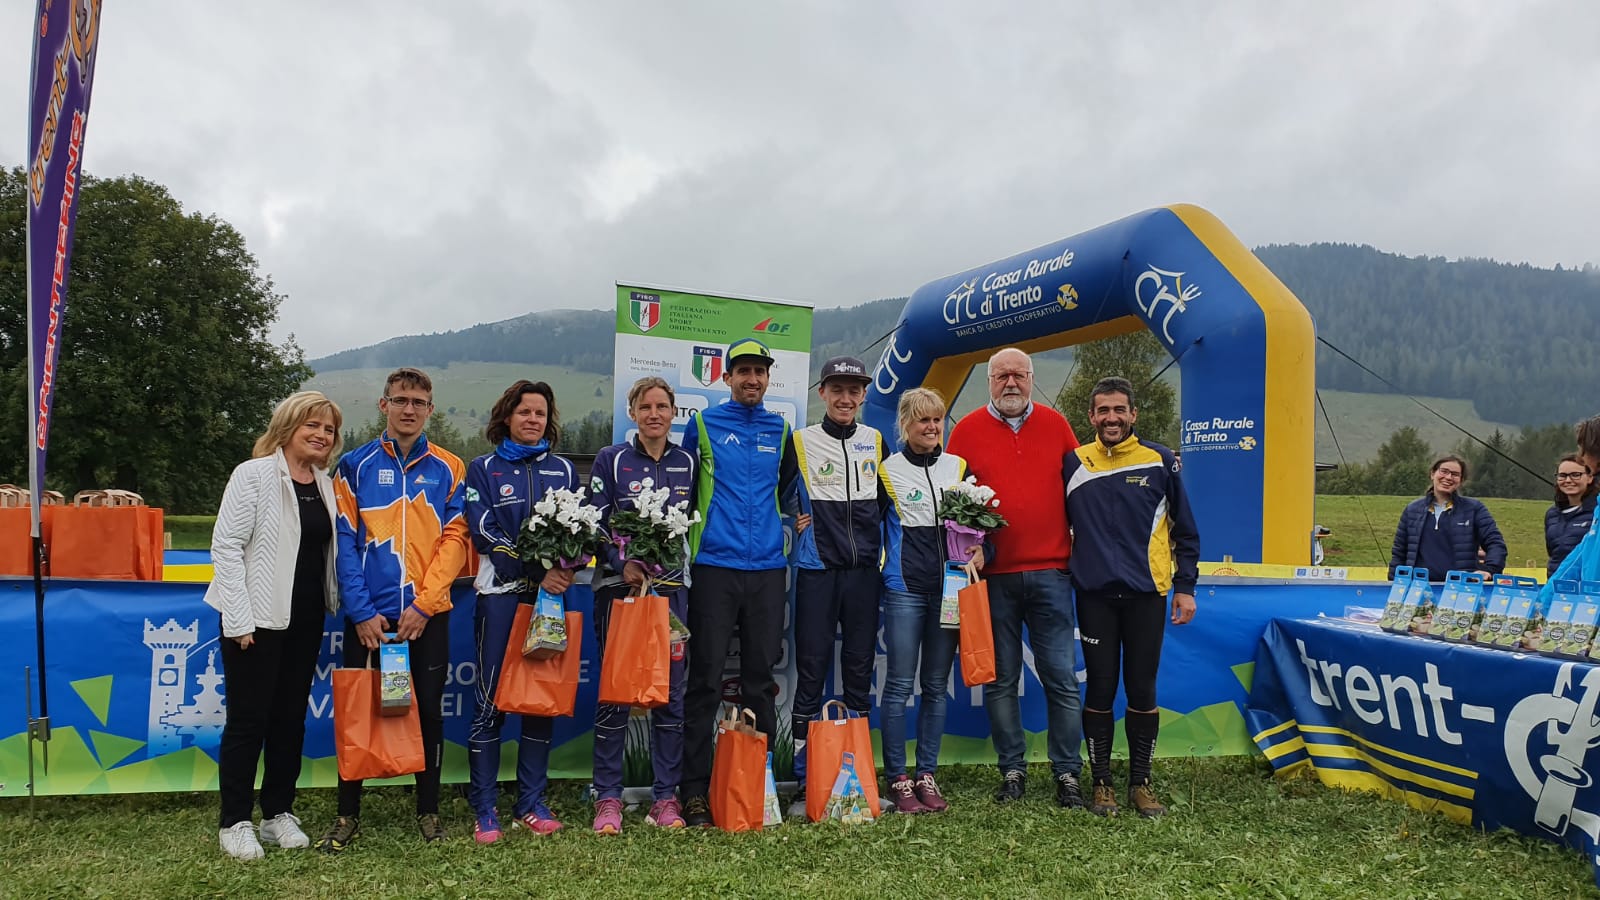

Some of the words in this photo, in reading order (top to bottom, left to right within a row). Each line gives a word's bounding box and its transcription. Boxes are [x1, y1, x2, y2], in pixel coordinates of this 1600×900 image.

[982, 270, 1020, 293] Cassa
[1025, 249, 1075, 277] Rurale
[37, 109, 85, 449] ORIENTEERING
[980, 293, 993, 316] di
[996, 285, 1042, 312] Trento
[669, 305, 722, 316] FEDERAZIONE
[669, 311, 703, 320] ITALIANA
[669, 317, 693, 326] SPORT
[955, 327, 977, 338] BANCA
[985, 317, 1014, 330] CREDITO
[1014, 304, 1062, 323] COOPERATIVO
[668, 324, 728, 336] ORIENTAMENTO
[1185, 419, 1210, 432] Cassa
[1212, 416, 1255, 430] Rurale
[1192, 431, 1228, 443] Trento
[1200, 444, 1240, 452] COOPERATIVO
